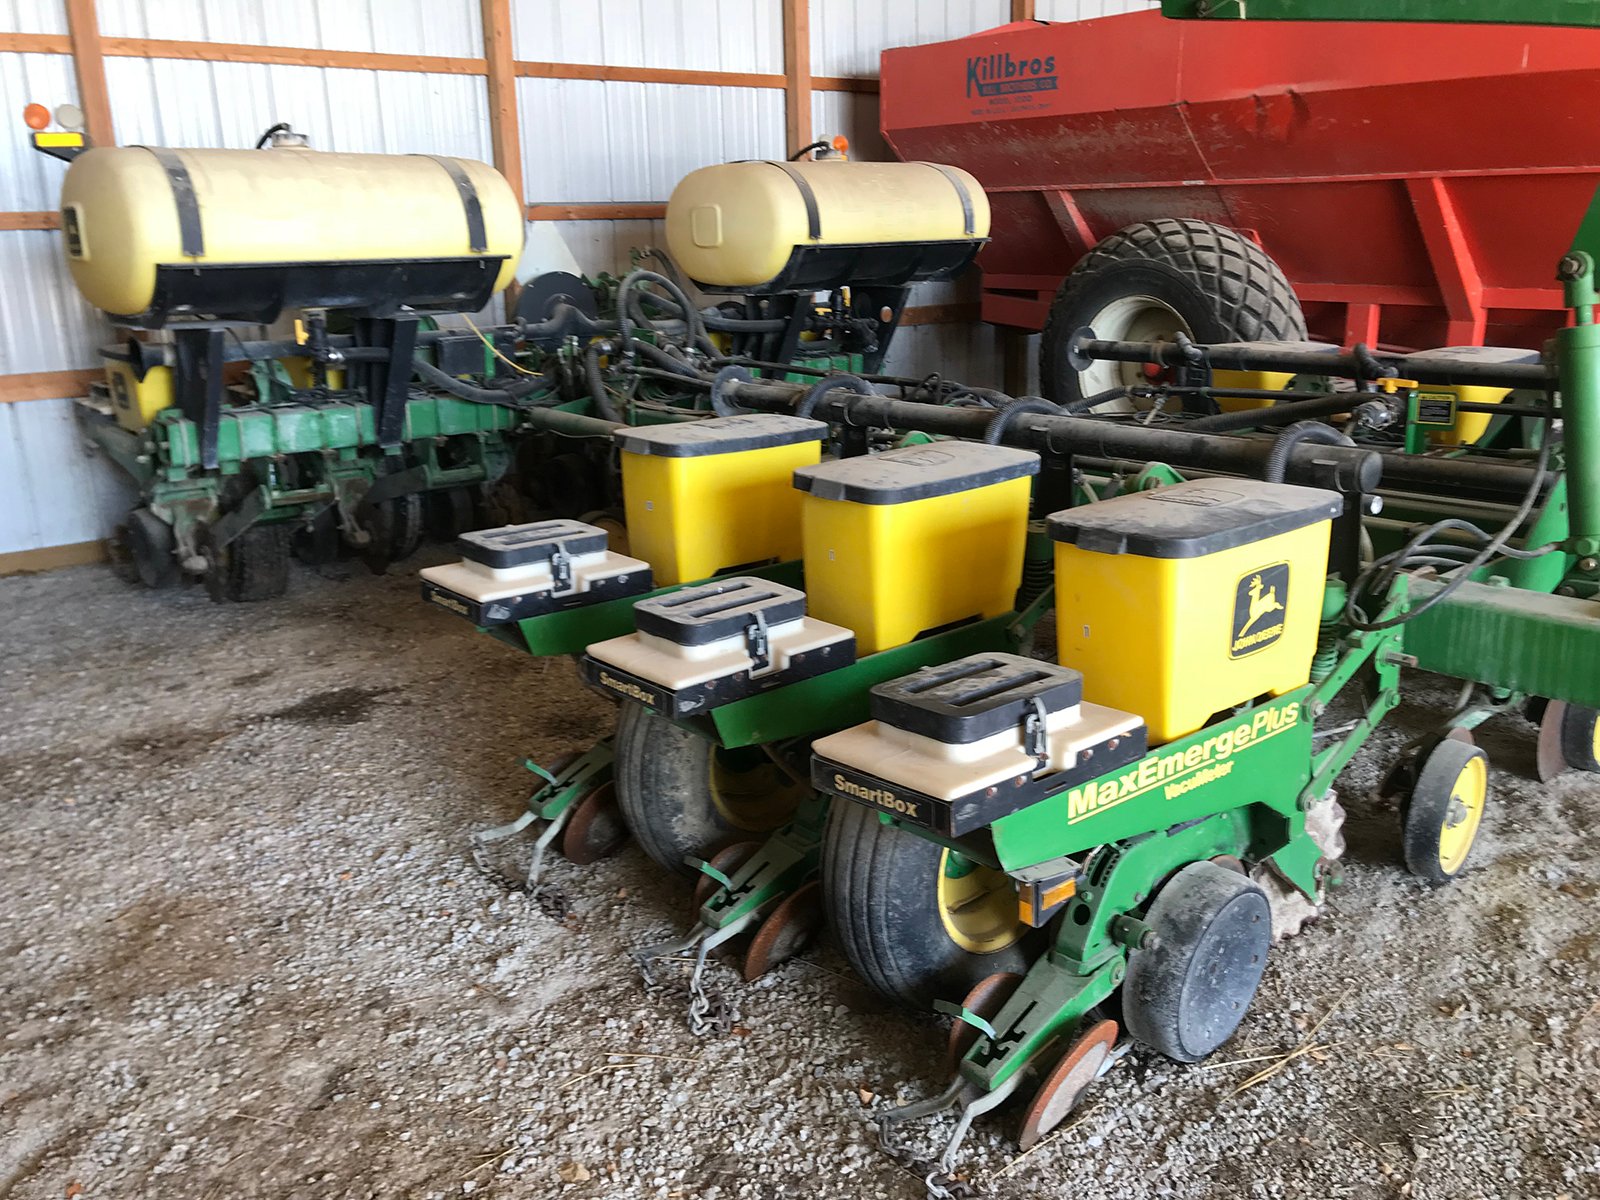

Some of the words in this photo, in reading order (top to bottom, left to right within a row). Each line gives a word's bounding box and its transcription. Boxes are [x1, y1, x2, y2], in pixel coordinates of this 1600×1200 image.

[967, 52, 1055, 98] Killbros
[600, 671, 655, 705] SmartBox
[834, 774, 918, 817] SmartBox
